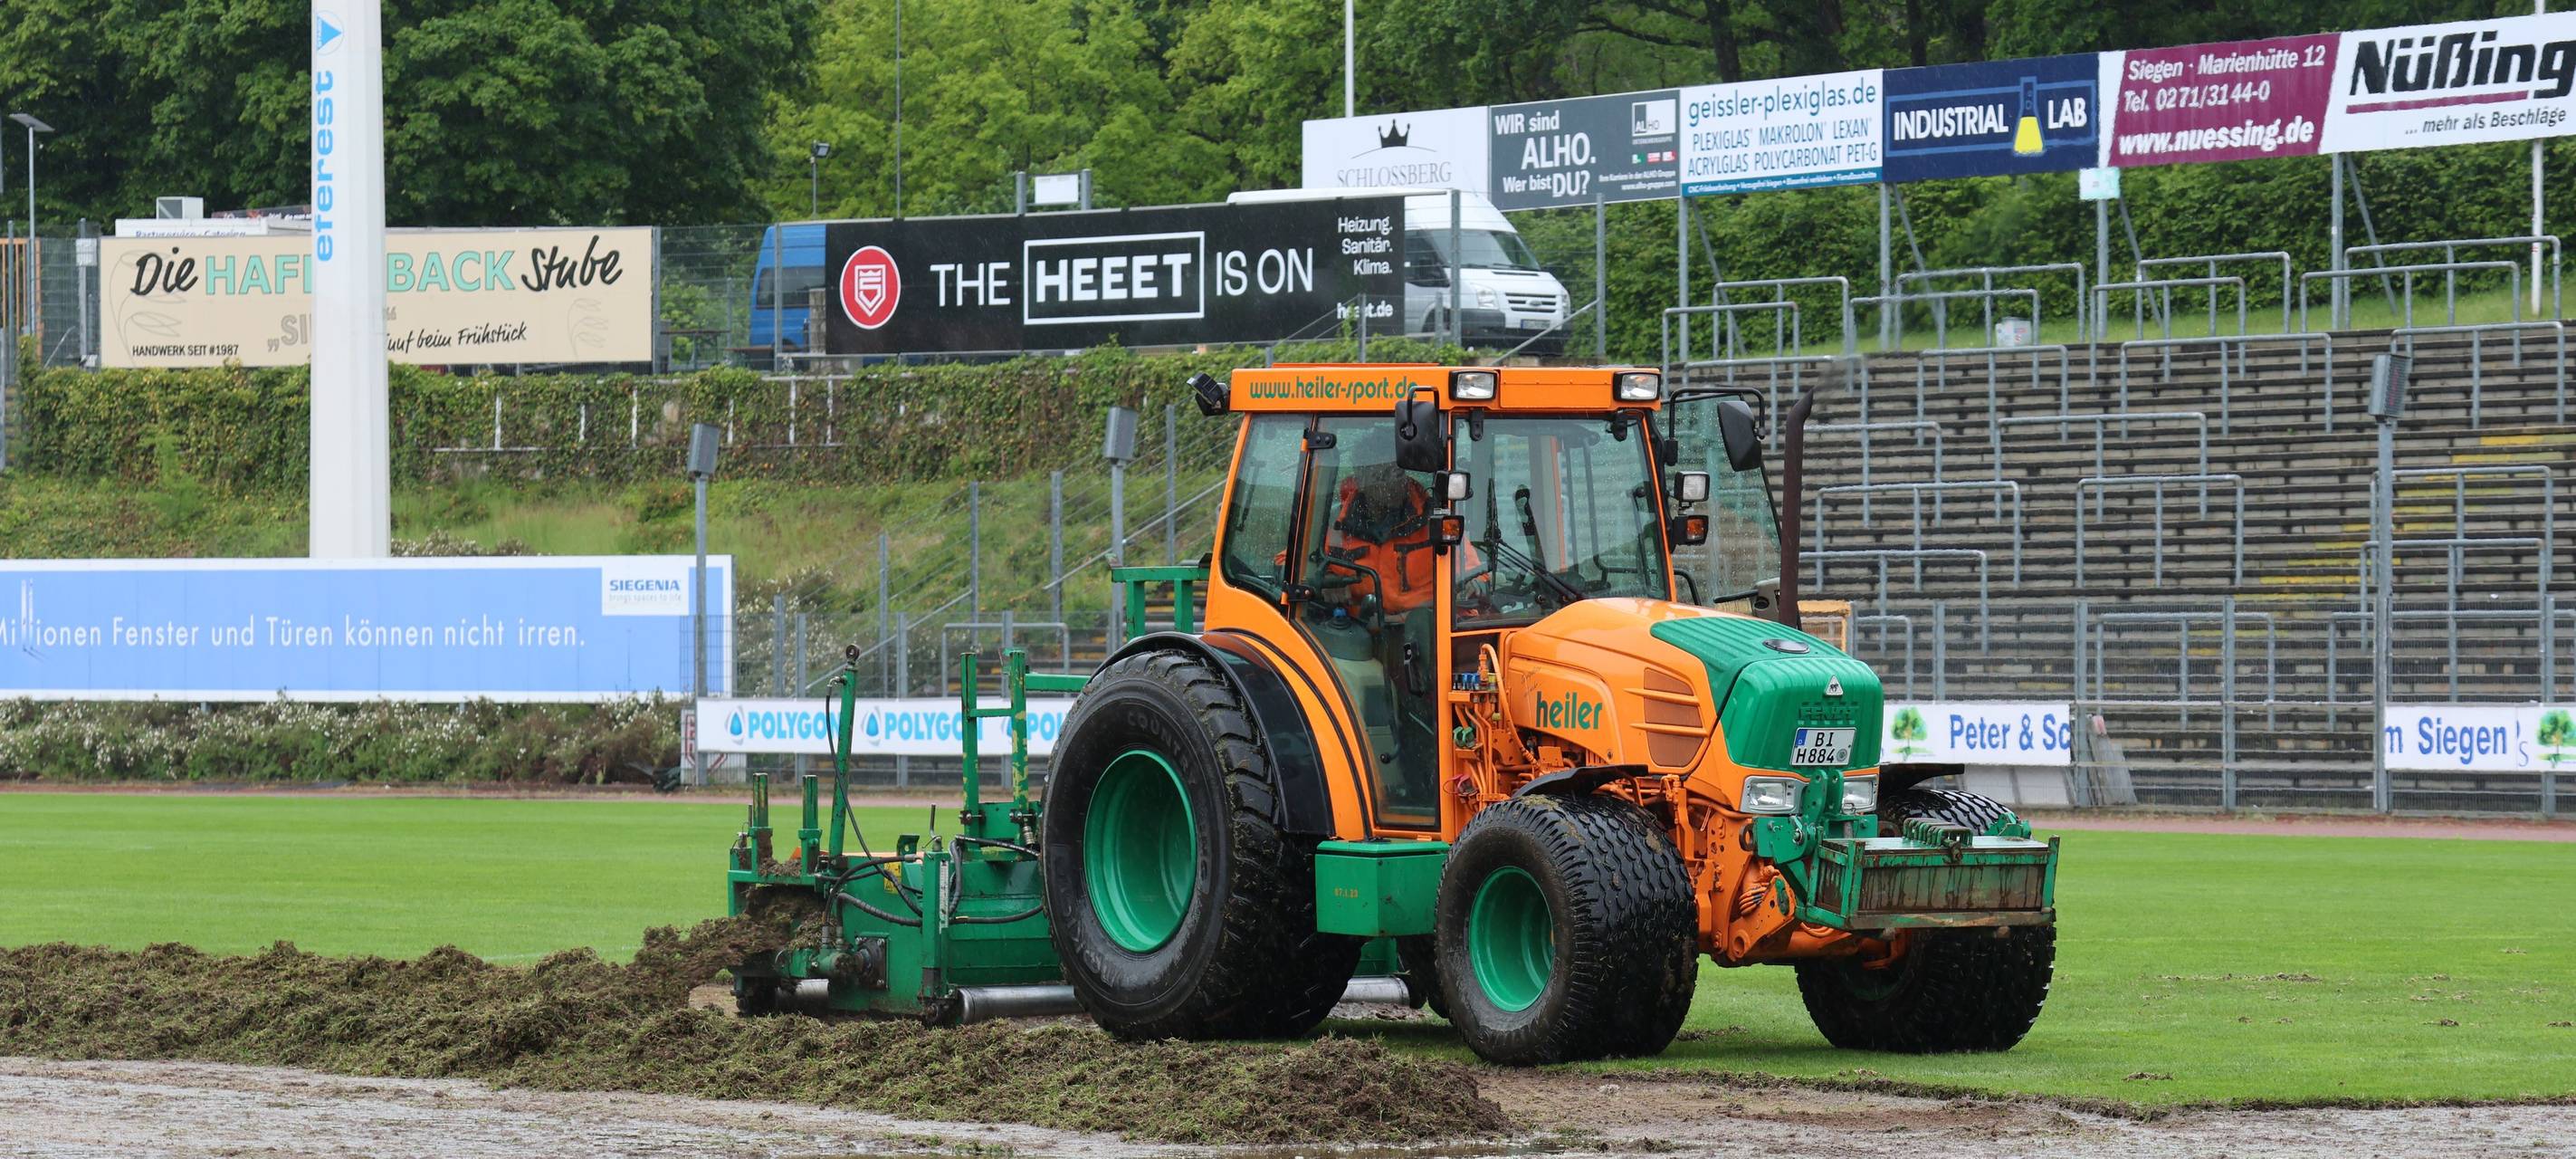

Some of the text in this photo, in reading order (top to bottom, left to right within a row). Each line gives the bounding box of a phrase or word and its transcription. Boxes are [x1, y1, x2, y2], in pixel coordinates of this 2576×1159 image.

[2128, 59, 2183, 83] Siegen
[2198, 48, 2299, 75] Marienhütte
[2303, 44, 2326, 67] 12
[2349, 30, 2576, 100] Nüßing
[1689, 76, 1876, 127] geissler-plexiglas.de
[2123, 80, 2271, 112] Tel. 0271/3144-0
[1494, 110, 1560, 135] WIR sind
[1894, 98, 2087, 141] INDUSTRIAL LAB
[2119, 115, 2315, 156] www.nuessing.de
[2422, 114, 2460, 134] mehr
[2463, 113, 2486, 130] als
[2491, 105, 2566, 128] Beschläge
[314, 71, 334, 262] eferest
[1521, 131, 1597, 170] ALHO.
[1687, 152, 1750, 177] ACRYLGLAS
[1753, 144, 1842, 172] POLYCARBONAT
[1846, 141, 1877, 164] PET-G
[1336, 161, 1453, 187] SCHLOSSBERG
[1503, 170, 1591, 197] Wer bist DU?
[1337, 216, 1393, 235] Heizung.
[1341, 237, 1393, 254] Sanitär.
[130, 246, 198, 296] Die
[521, 235, 624, 292] Stube
[930, 247, 1313, 307] THE HEEET IS ON
[1353, 258, 1393, 275] Klima.
[132, 344, 239, 357] HANDWERK SEIT #1987
[416, 329, 452, 350] beim
[457, 321, 528, 346] Frühstück
[1250, 376, 1418, 404] www.heiler-sport.de
[609, 579, 681, 592] SIEGENIA
[112, 617, 200, 647] Fenster
[212, 614, 255, 647] und
[266, 617, 333, 647] Türen
[345, 614, 434, 647] können
[444, 614, 504, 647] nicht
[519, 618, 586, 647] irren.
[1535, 691, 1603, 730] heiler
[1815, 732, 1835, 747] BI
[1950, 714, 2011, 750] Peter
[2018, 713, 2034, 751] &
[2418, 717, 2507, 764] Siegen
[1795, 748, 1836, 763] H884
